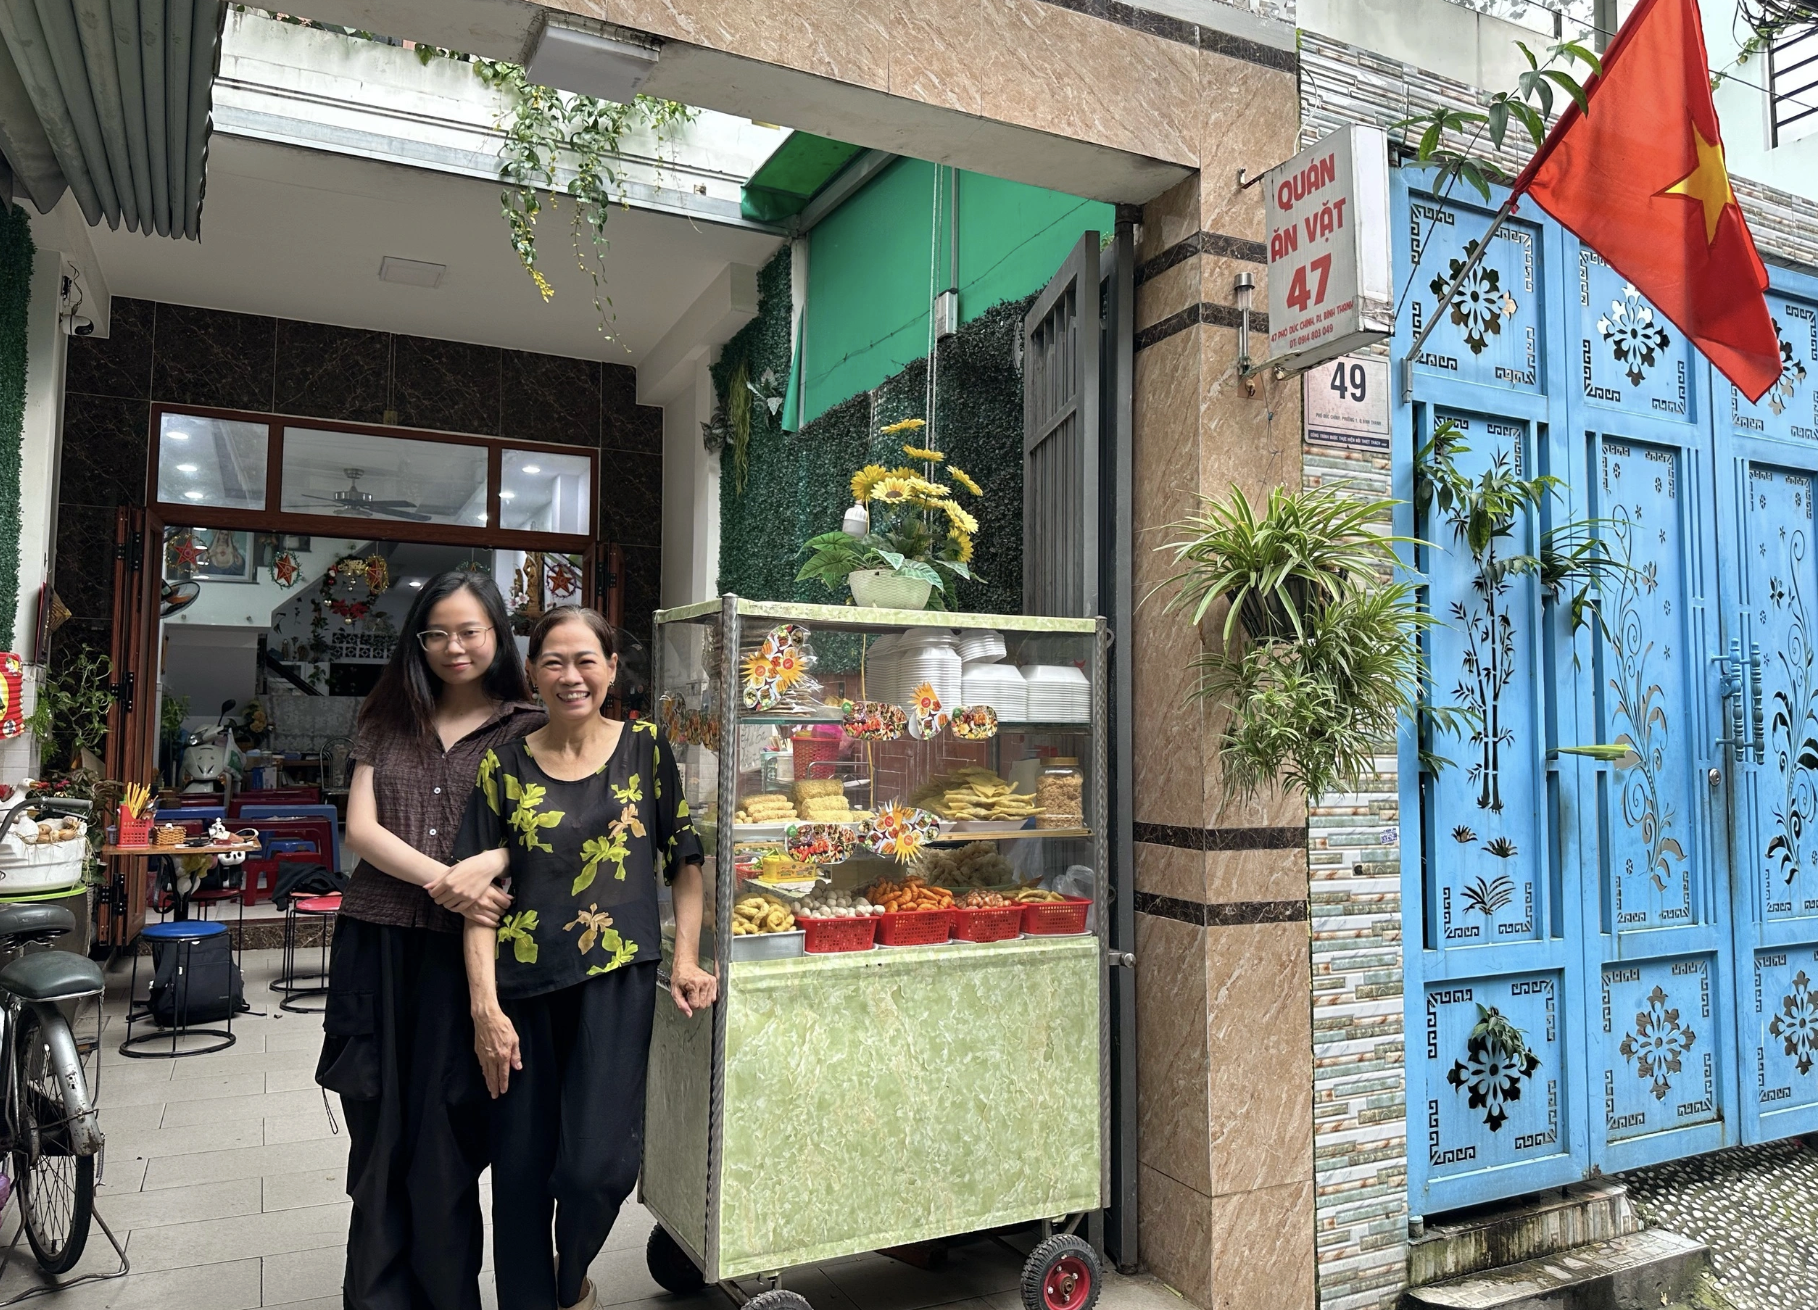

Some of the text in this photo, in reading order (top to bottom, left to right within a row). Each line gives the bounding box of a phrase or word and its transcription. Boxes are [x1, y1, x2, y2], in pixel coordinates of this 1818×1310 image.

[1277, 153, 1336, 212] QUÁN
[1271, 197, 1347, 263] ĂN VẶT
[1286, 252, 1332, 313] 47
[1311, 328, 1321, 340] 803
[1322, 323, 1334, 336] 049
[1330, 361, 1366, 403] 49
